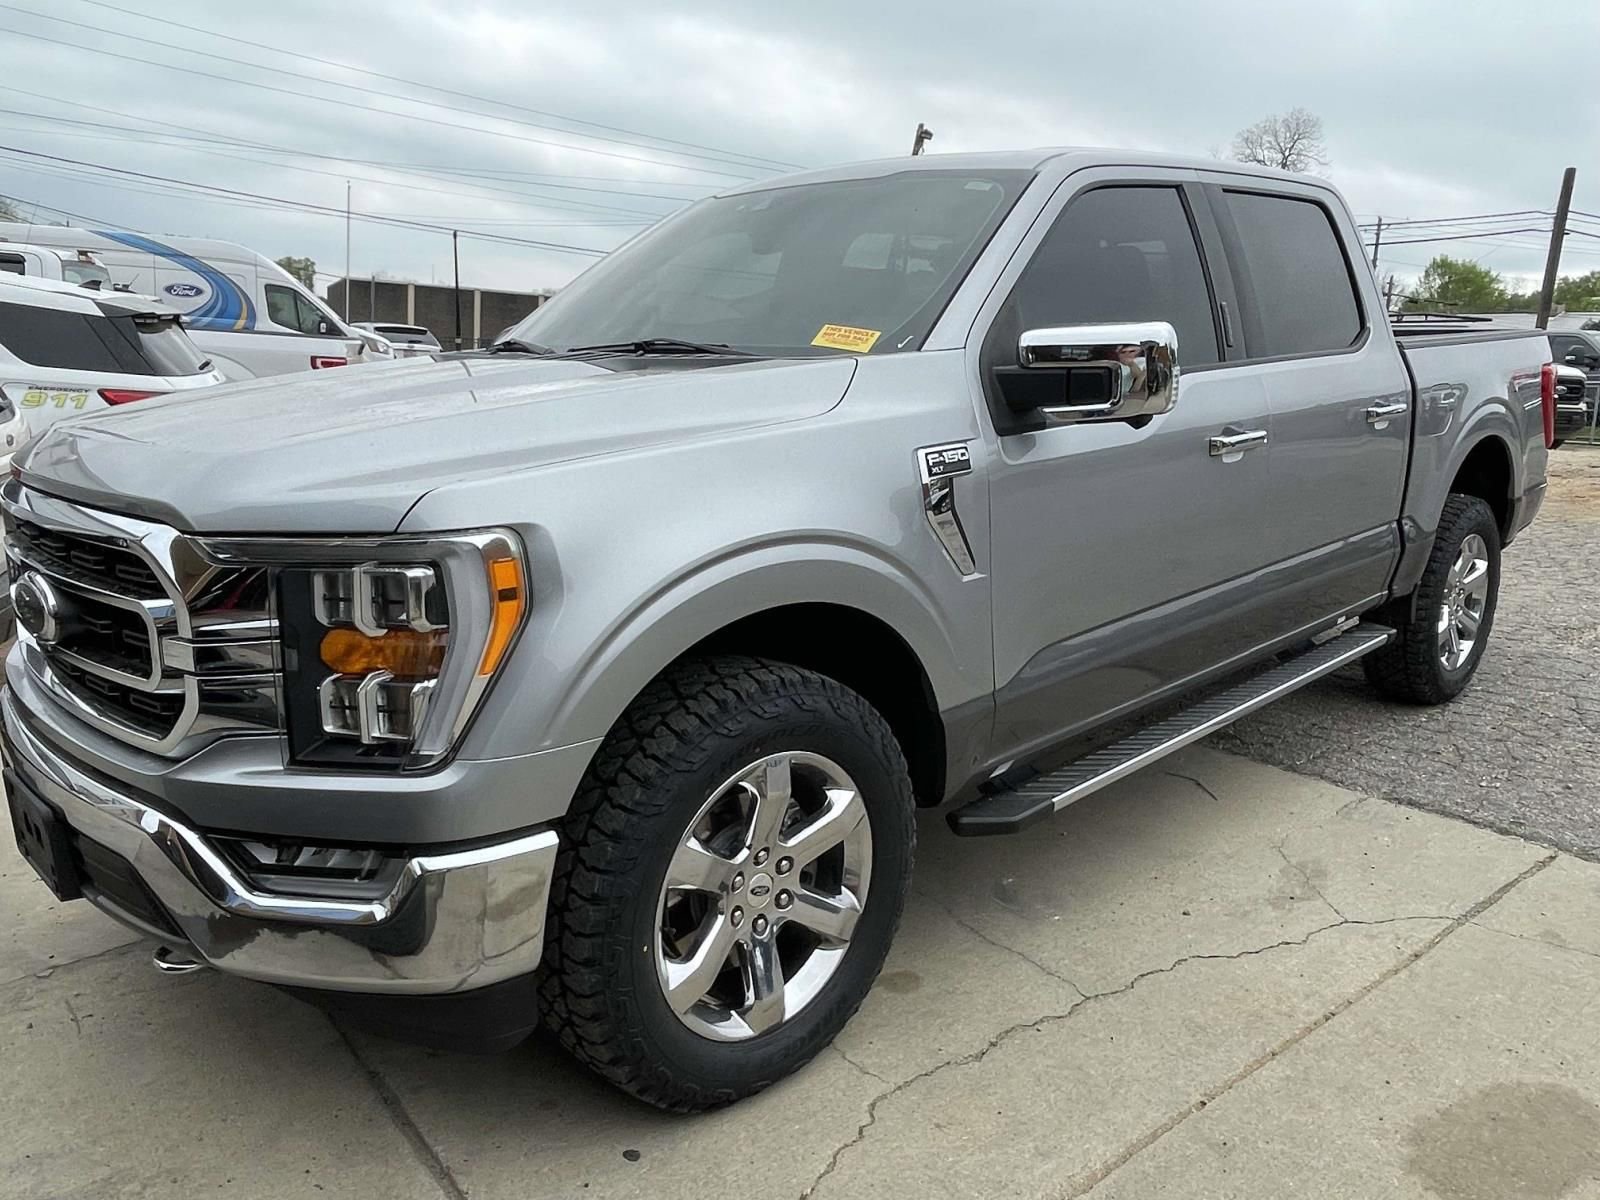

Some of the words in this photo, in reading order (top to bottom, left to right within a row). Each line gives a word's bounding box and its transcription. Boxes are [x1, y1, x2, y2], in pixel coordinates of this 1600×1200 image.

[171, 285, 197, 296] Ford
[844, 328, 876, 338] VEHICLE
[21, 391, 88, 410] 911
[927, 449, 969, 466] F-150
[931, 465, 944, 474] XLT
